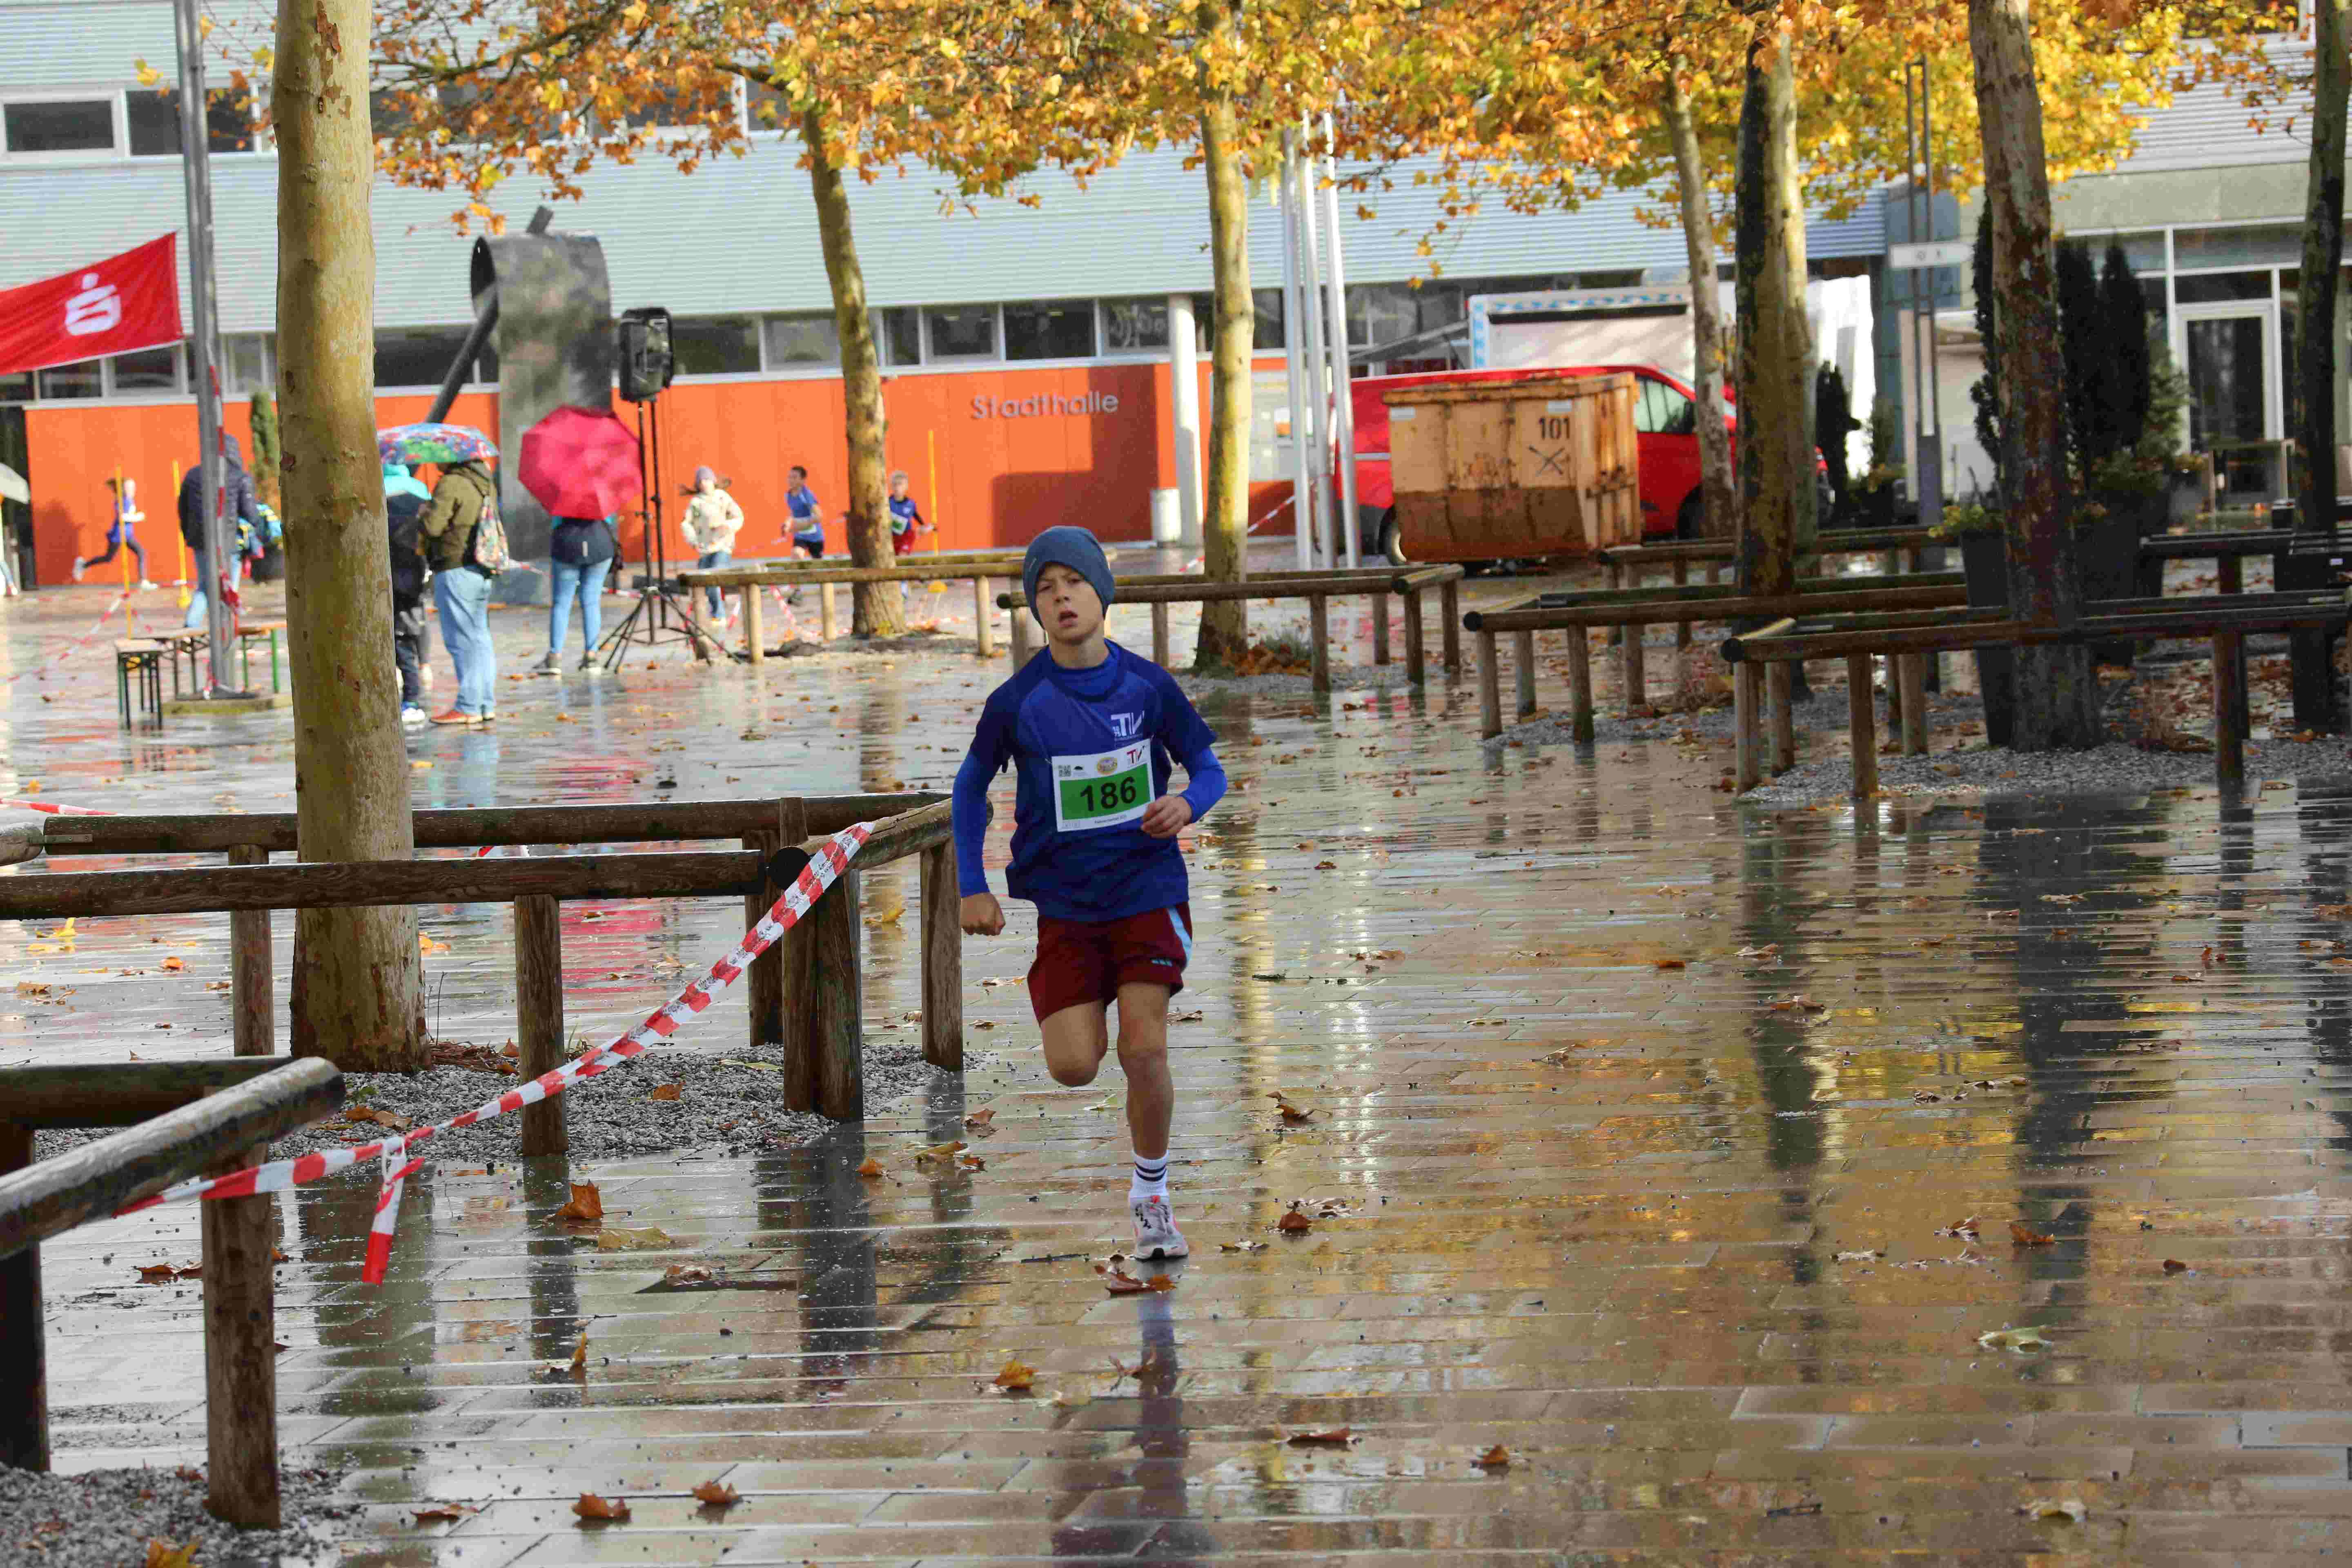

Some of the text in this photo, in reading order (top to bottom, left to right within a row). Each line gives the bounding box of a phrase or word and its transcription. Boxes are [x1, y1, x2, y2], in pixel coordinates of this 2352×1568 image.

[971, 391, 1119, 419] Stadthalle
[1538, 416, 1570, 440] 101
[1080, 777, 1136, 812] 186
